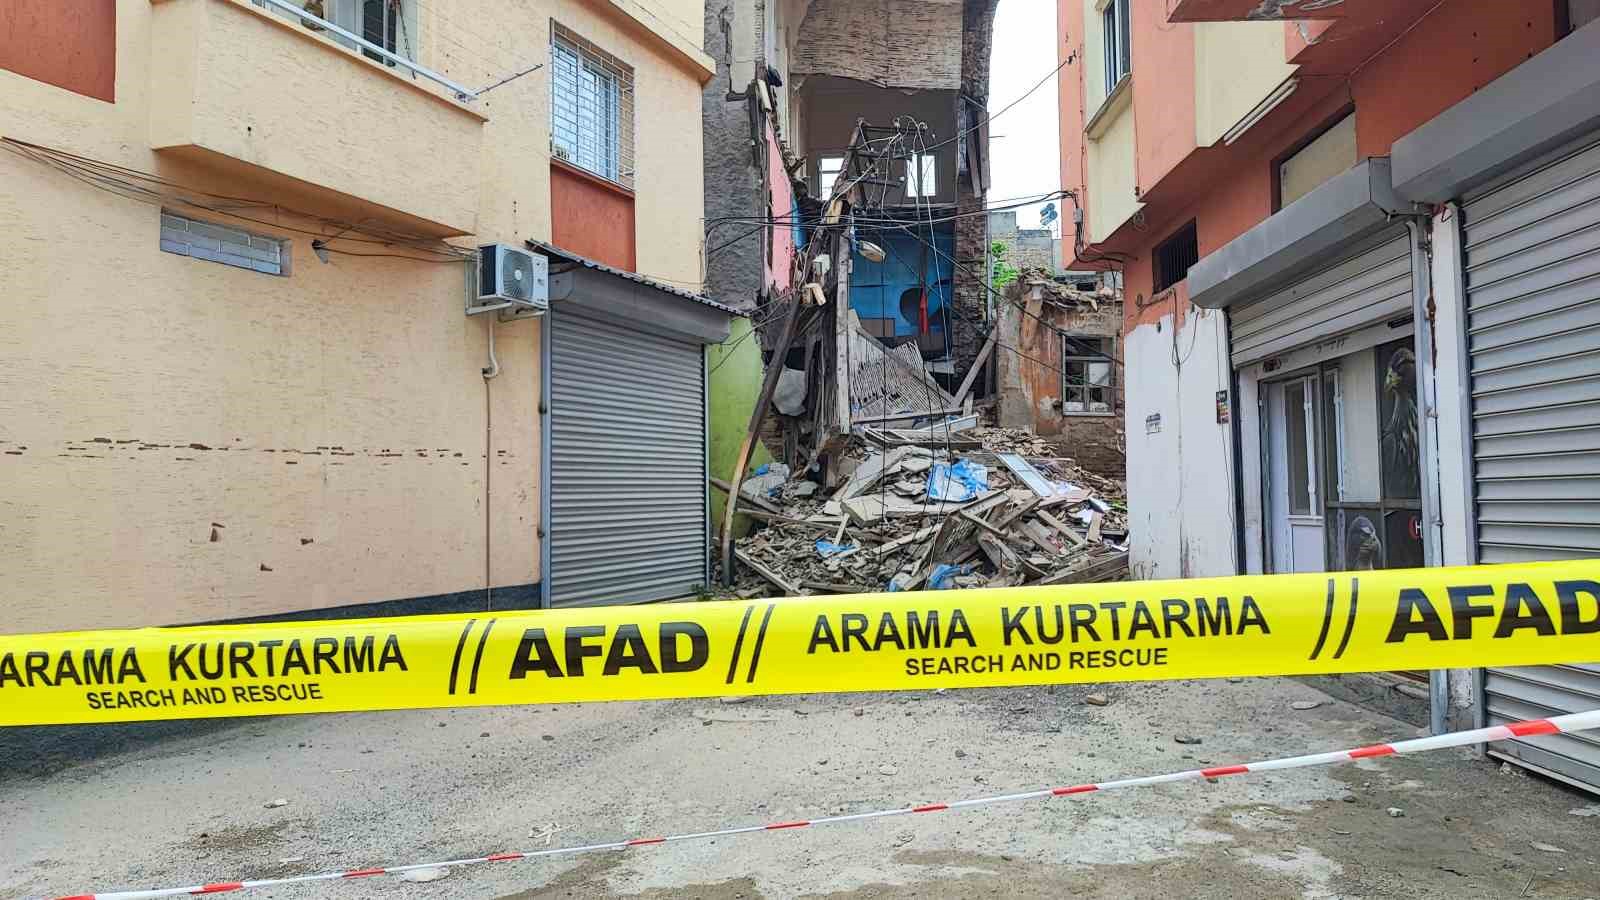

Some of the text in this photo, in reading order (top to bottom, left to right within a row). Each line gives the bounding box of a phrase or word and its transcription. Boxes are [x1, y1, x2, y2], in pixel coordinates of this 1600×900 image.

[807, 595, 1271, 655] ARAMA KURTARMA
[1384, 579, 1600, 644] AFAD
[0, 634, 409, 689] ARAMA KURTARMA
[508, 621, 710, 680] AFAD
[905, 647, 1168, 676] SEARCH AND RESCUE
[86, 683, 324, 710] SEARCH AND RESCUE
